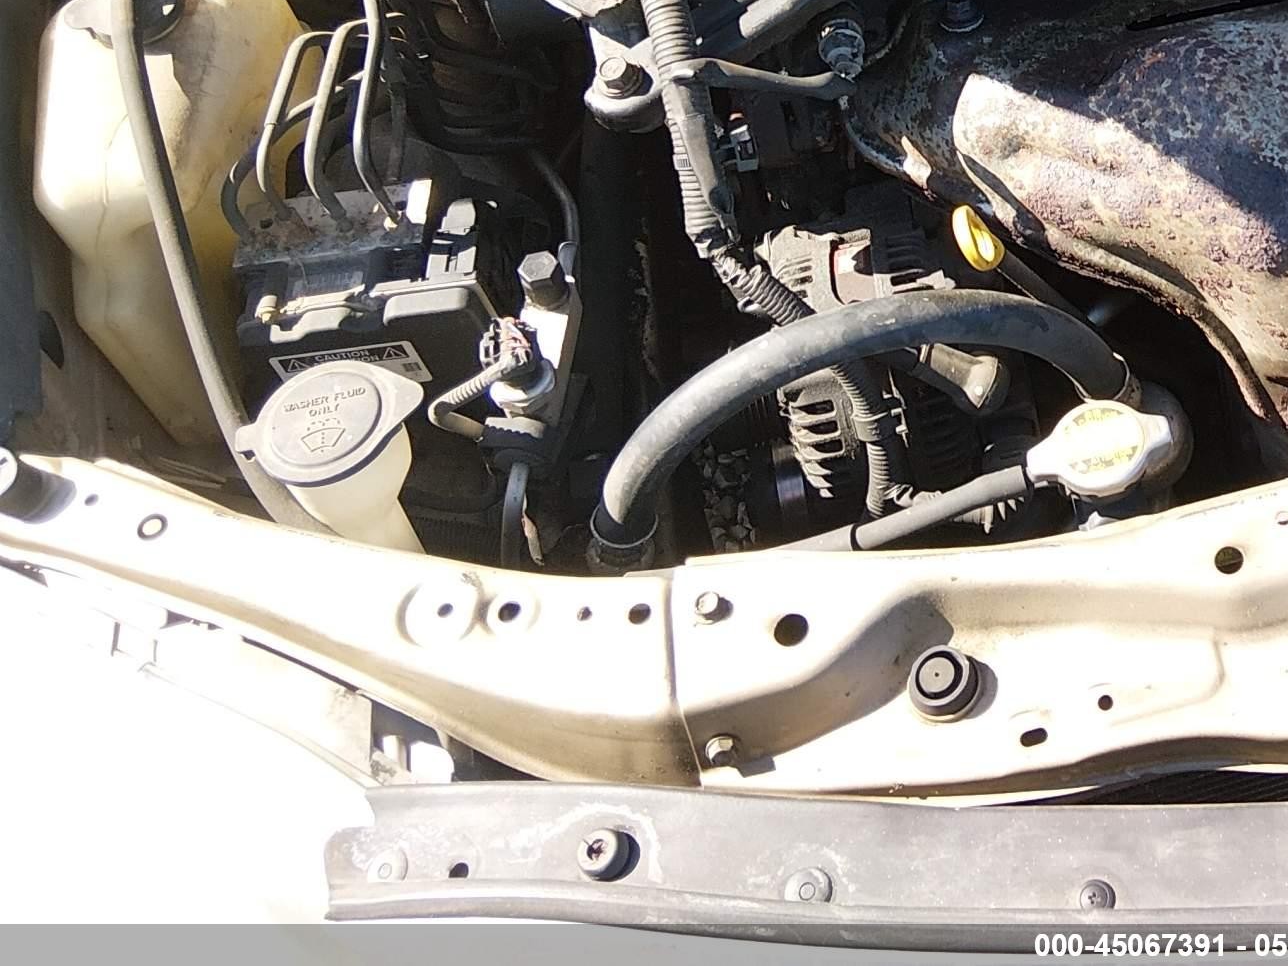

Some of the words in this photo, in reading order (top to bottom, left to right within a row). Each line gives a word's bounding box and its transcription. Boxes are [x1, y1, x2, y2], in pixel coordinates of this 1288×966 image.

[314, 349, 370, 361] CAUTION
[283, 395, 329, 413] WASHER
[334, 386, 366, 402] FLUID
[308, 403, 340, 417] ONLY
